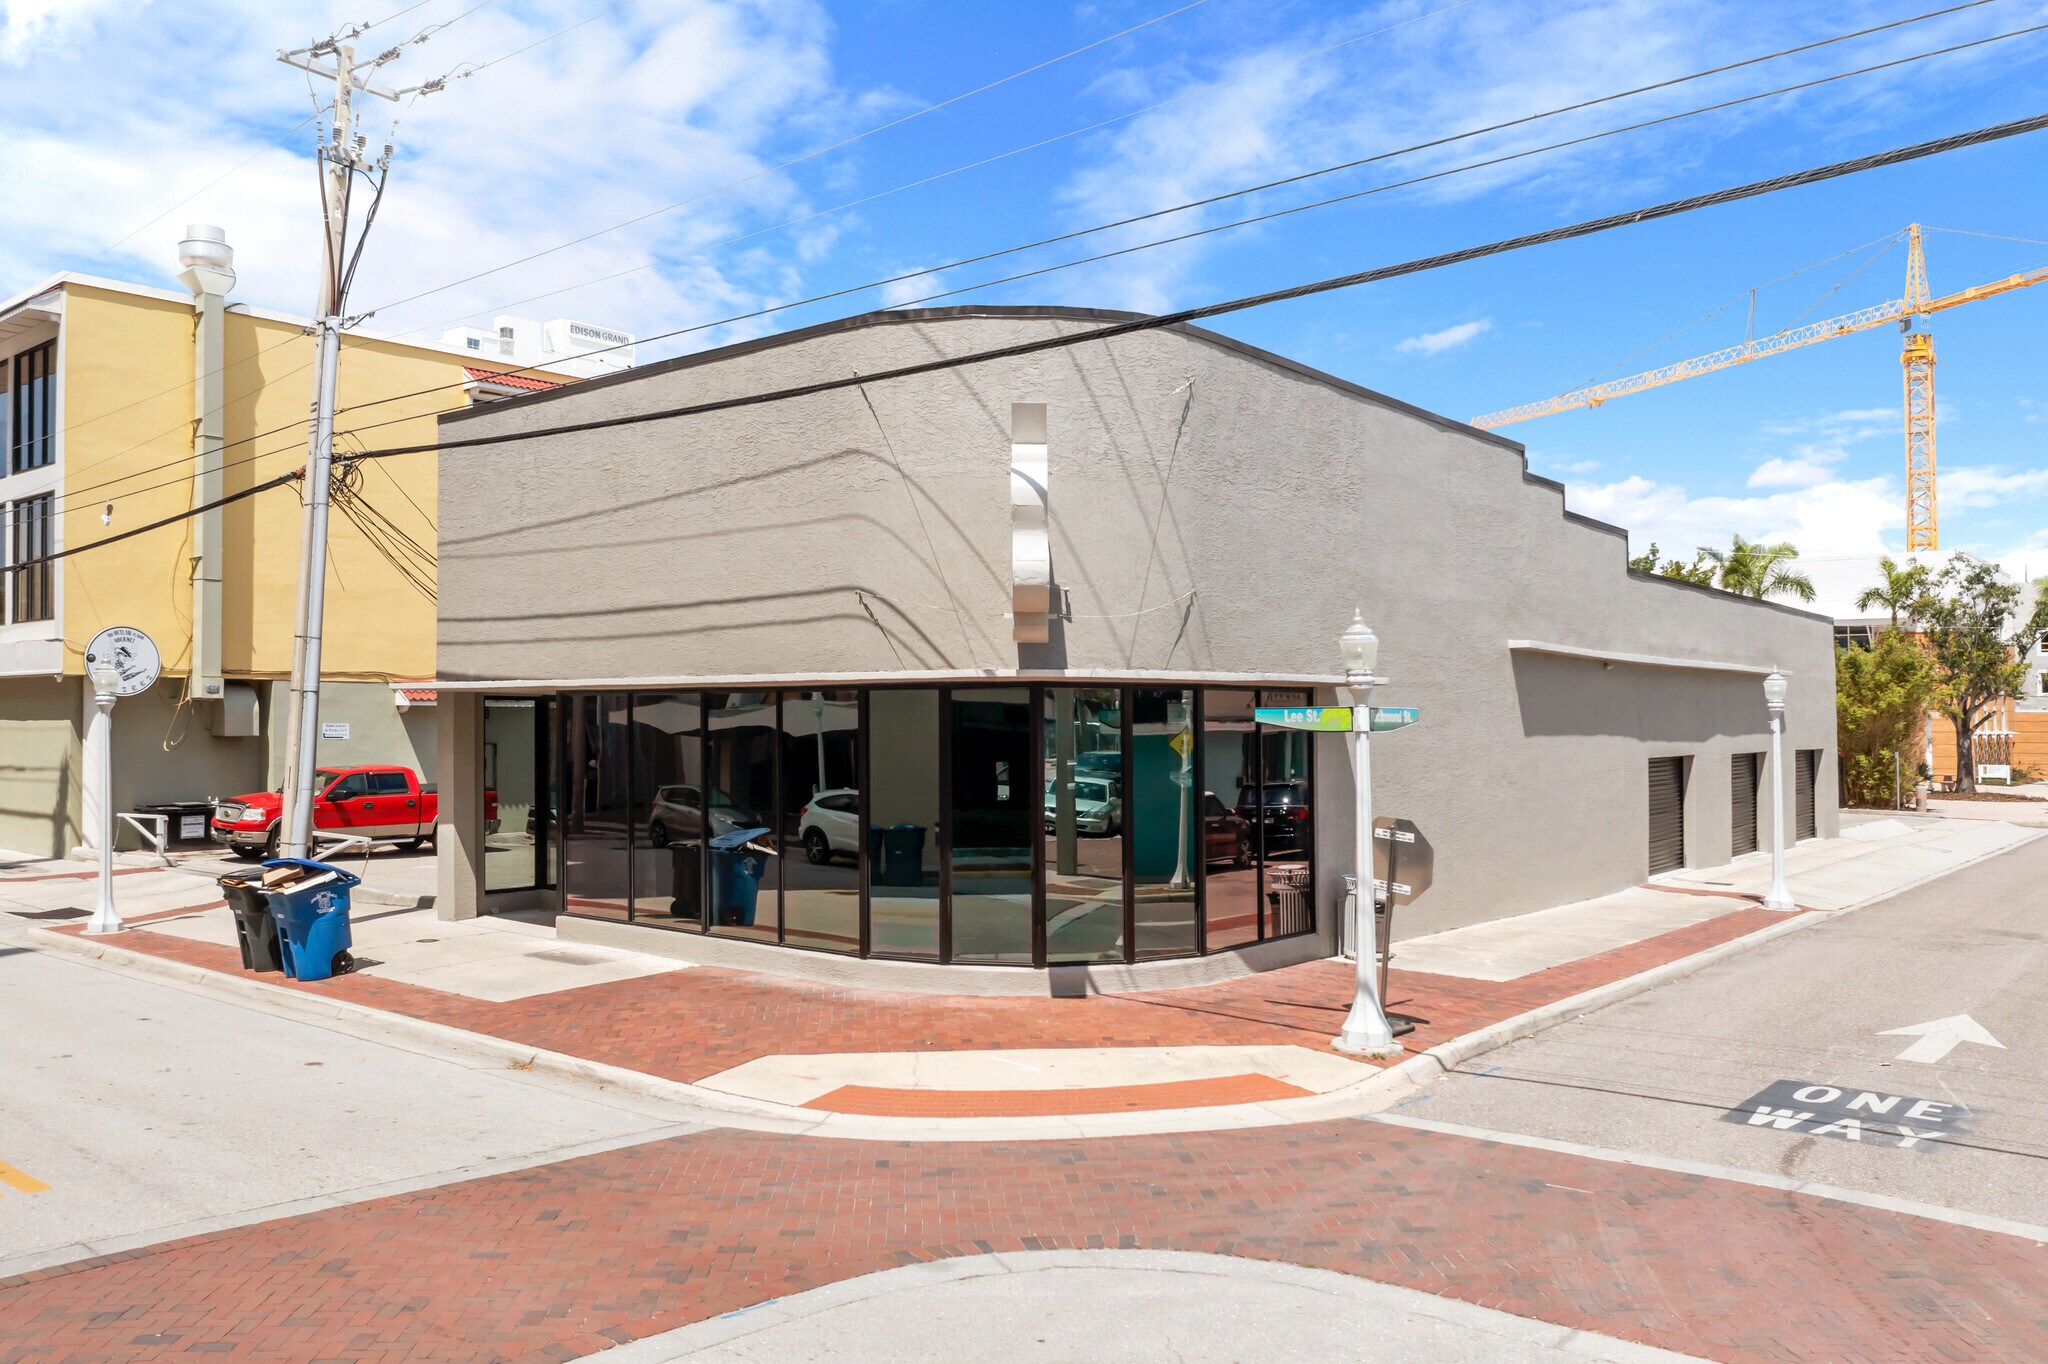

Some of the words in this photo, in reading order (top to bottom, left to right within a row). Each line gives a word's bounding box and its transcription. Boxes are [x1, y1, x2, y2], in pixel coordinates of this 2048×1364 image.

[570, 324, 601, 340] EDISON
[602, 332, 629, 345] GRAND
[1284, 709, 1303, 723] Lee
[1306, 709, 1321, 723] St.
[1792, 1085, 1953, 1122] ONE
[1747, 1105, 1947, 1148] WAY
